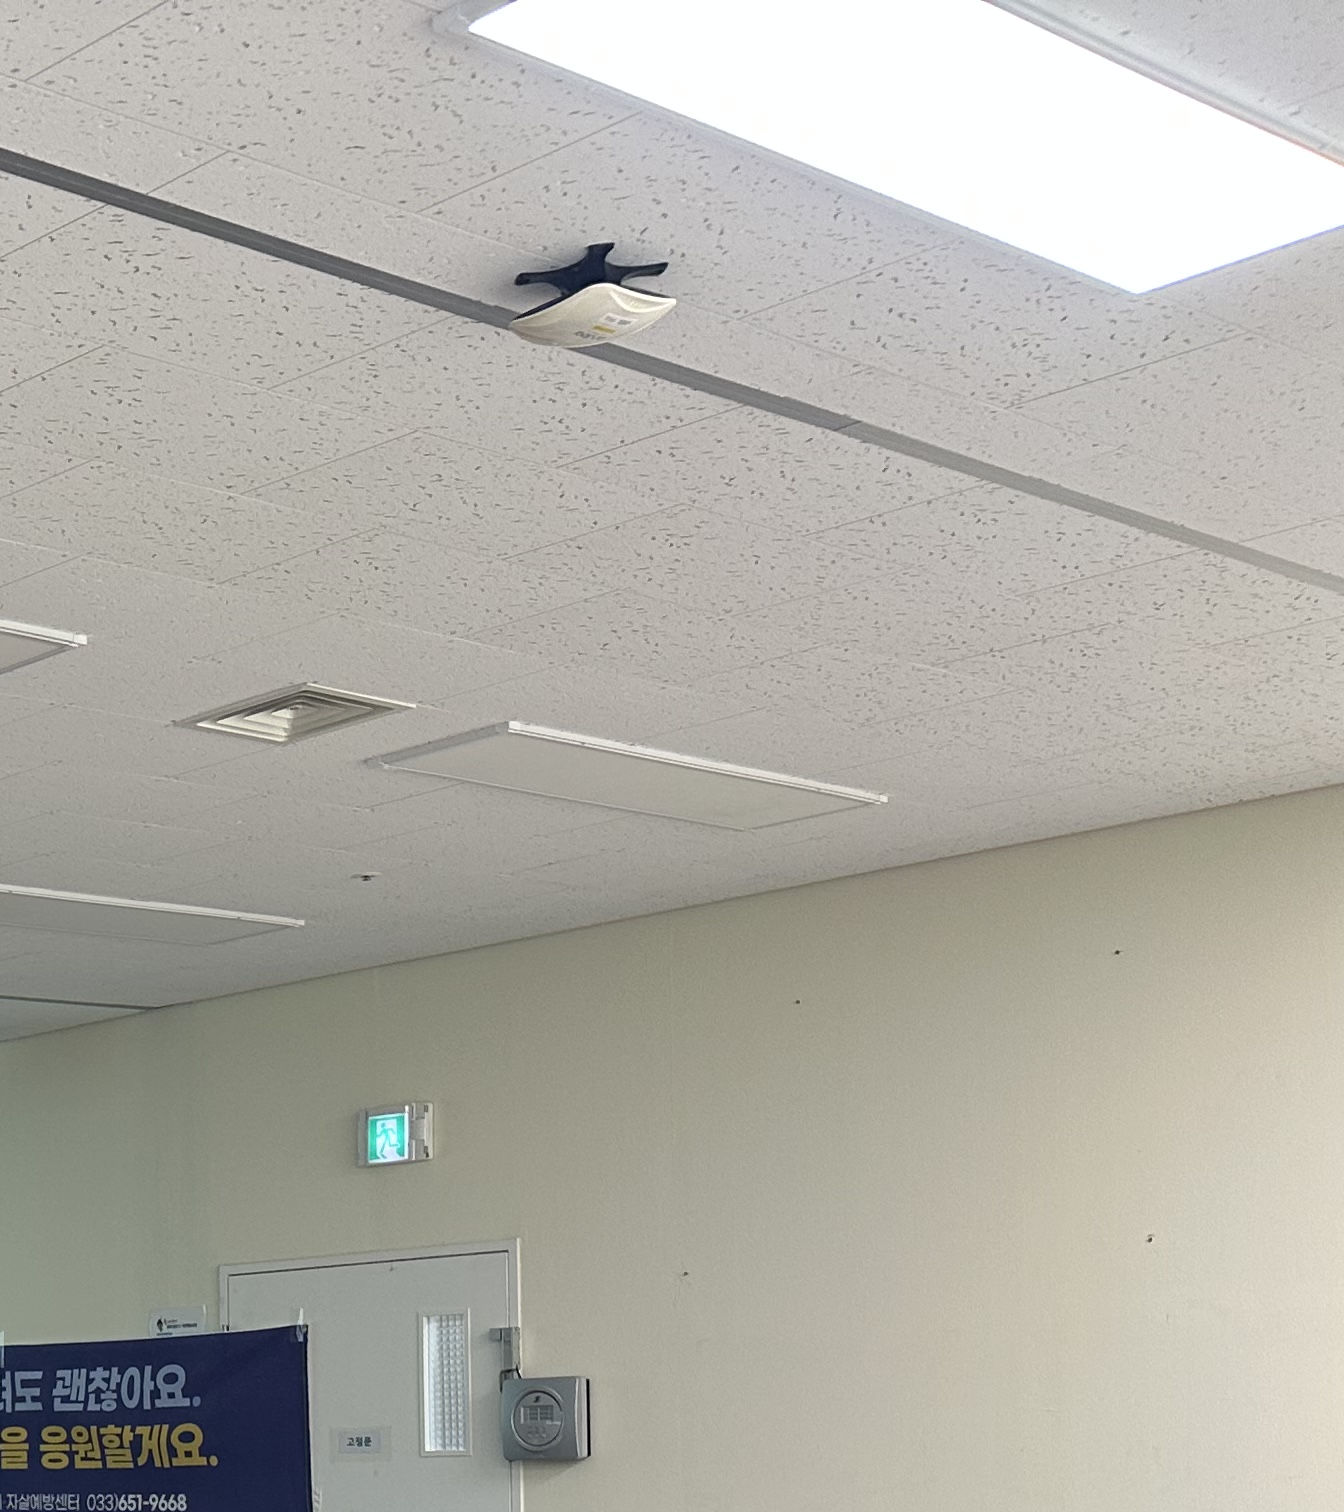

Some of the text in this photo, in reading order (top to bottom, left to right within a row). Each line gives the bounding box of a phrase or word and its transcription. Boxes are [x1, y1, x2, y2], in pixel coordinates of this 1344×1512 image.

[52, 1364, 202, 1412] 괜찮아요.
[39, 1423, 218, 1470] 응원할게요.
[6, 1493, 80, 1511] 자살예방센터
[87, 1494, 187, 1512] 033)651-9668
